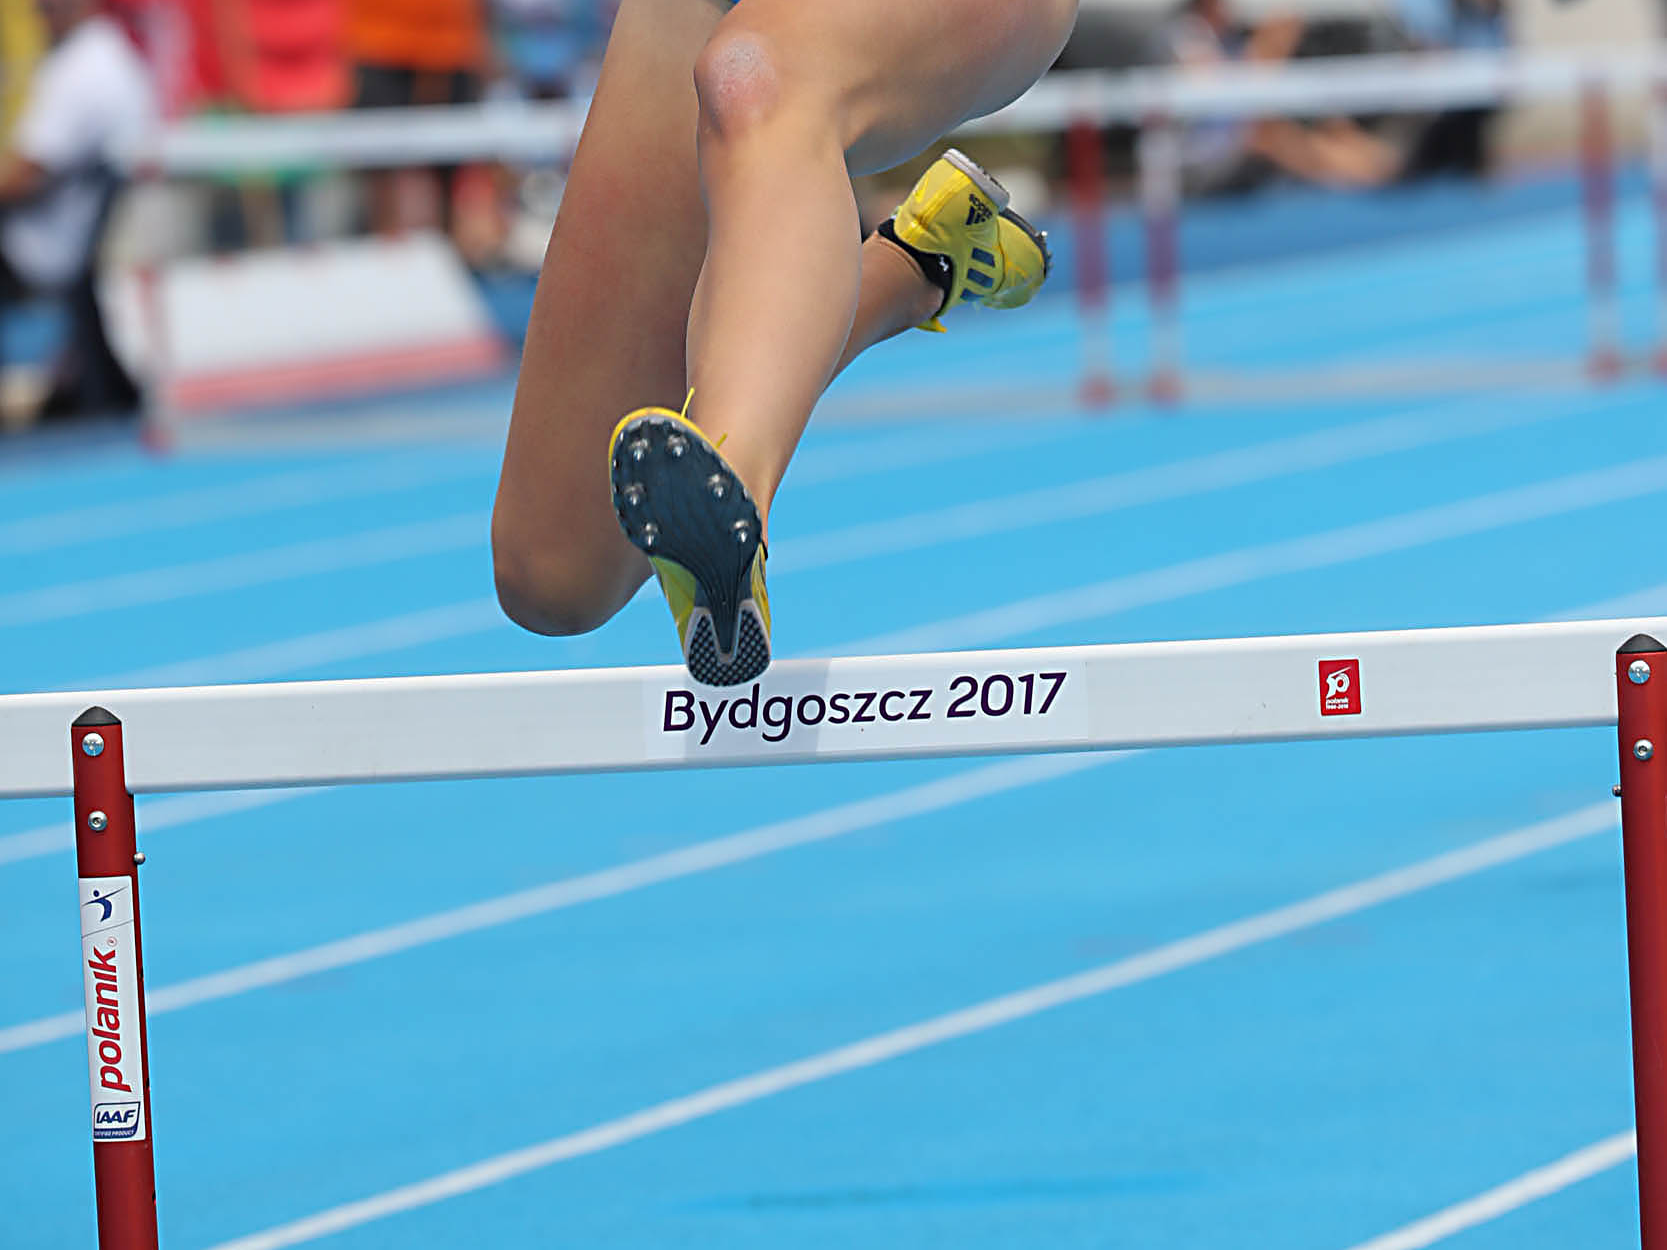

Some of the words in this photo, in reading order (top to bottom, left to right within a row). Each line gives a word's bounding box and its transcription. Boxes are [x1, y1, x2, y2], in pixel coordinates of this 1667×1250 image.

[663, 683, 933, 745] Bydgoszcz
[946, 671, 1068, 718] 2017
[87, 945, 132, 1093] polanik
[96, 1109, 136, 1124] IAAF
